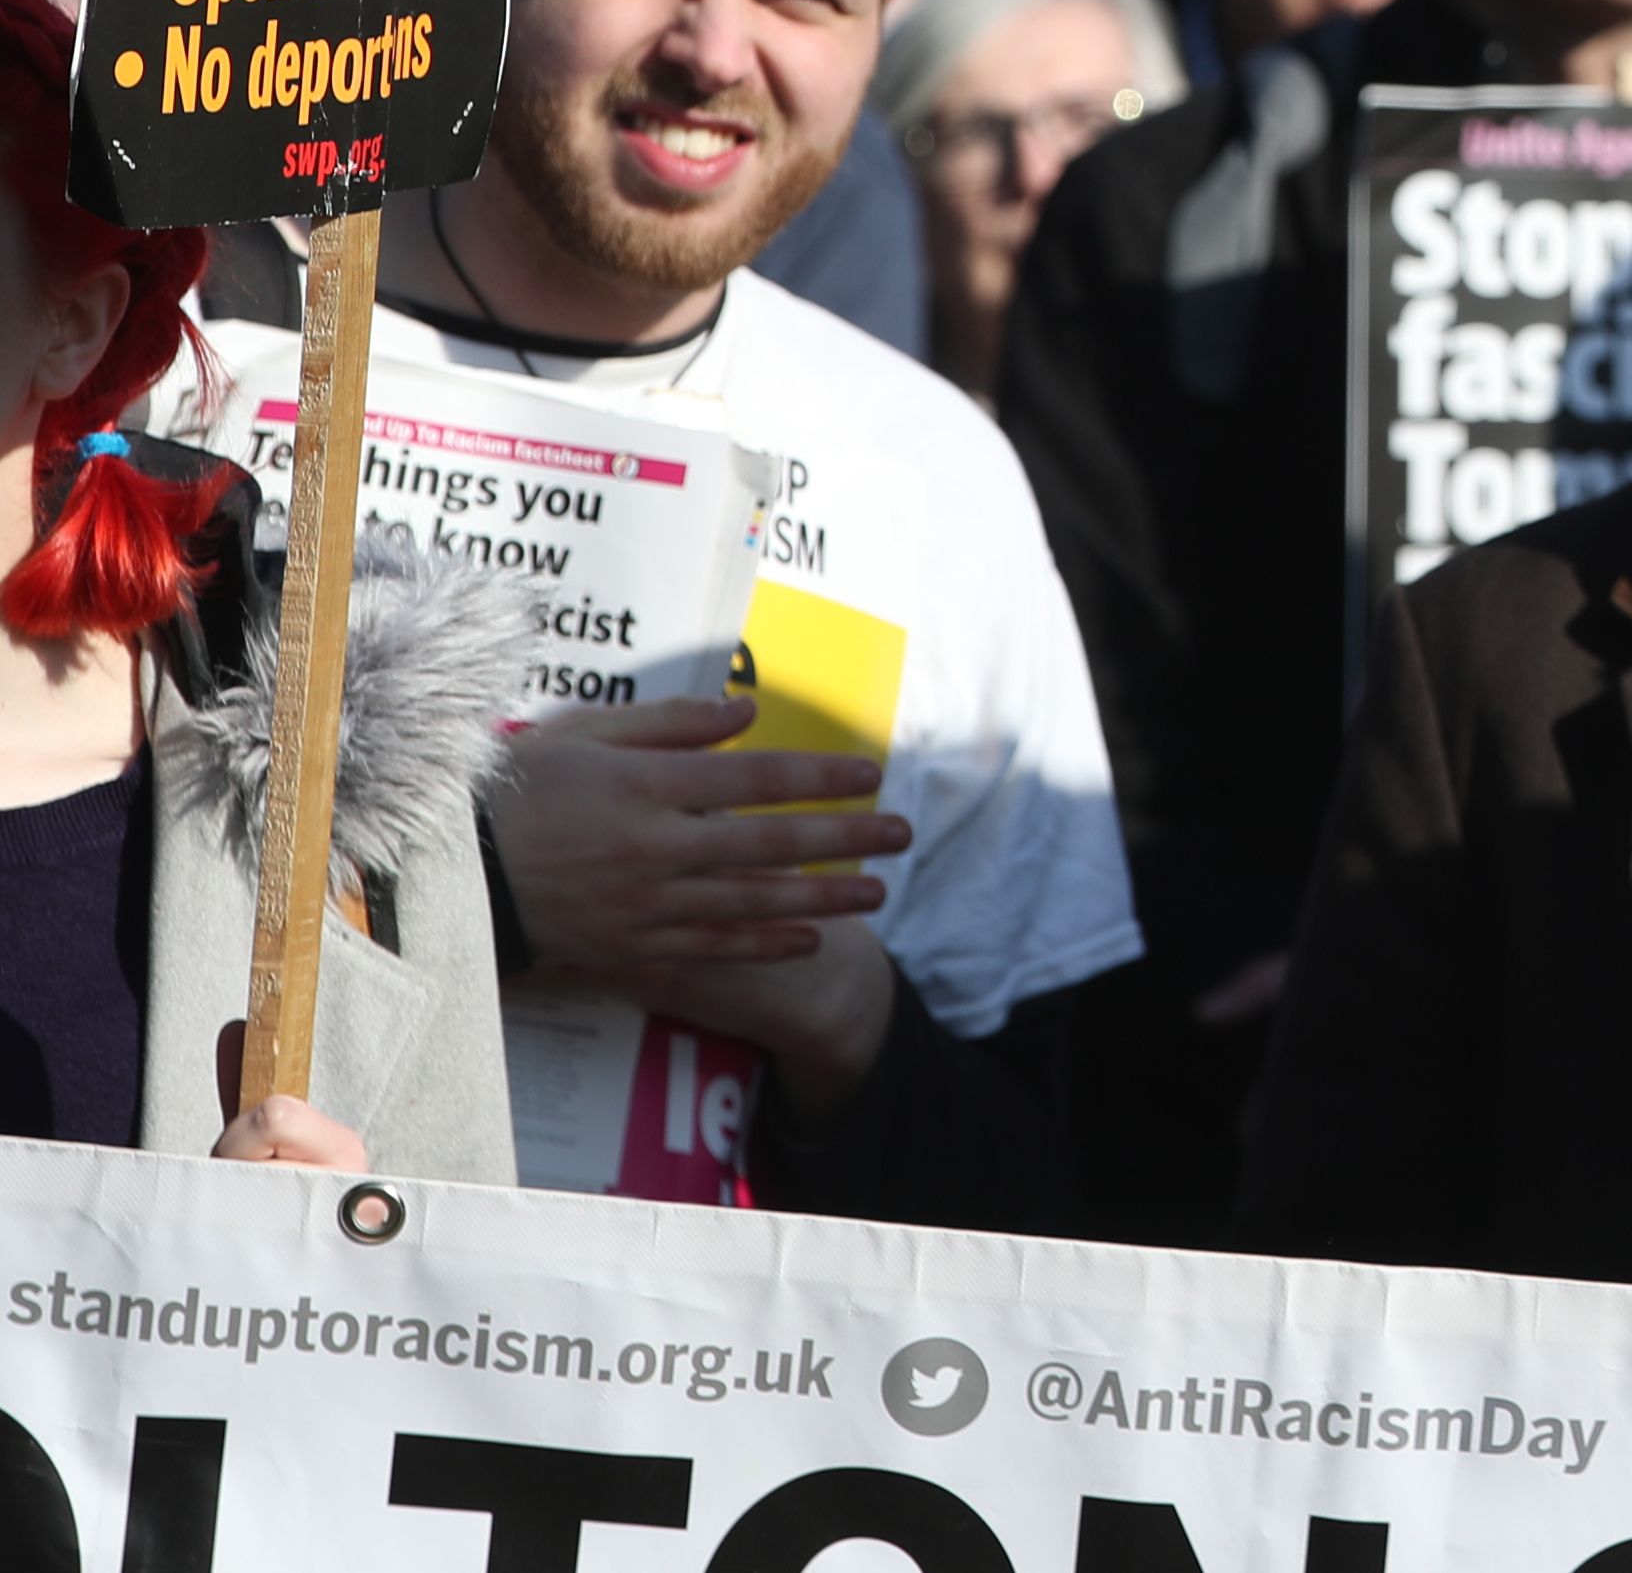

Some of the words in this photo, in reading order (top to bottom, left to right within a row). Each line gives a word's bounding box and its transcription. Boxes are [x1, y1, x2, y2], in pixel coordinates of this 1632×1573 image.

[162, 25, 231, 114] No
[249, 430, 293, 468] Te
[363, 444, 499, 511] hings
[514, 480, 605, 525] you
[433, 518, 571, 576] know
[6, 1271, 836, 1402] standuptoracism.org.uk
[1026, 1361, 1608, 1476] @AntiRacismDay
